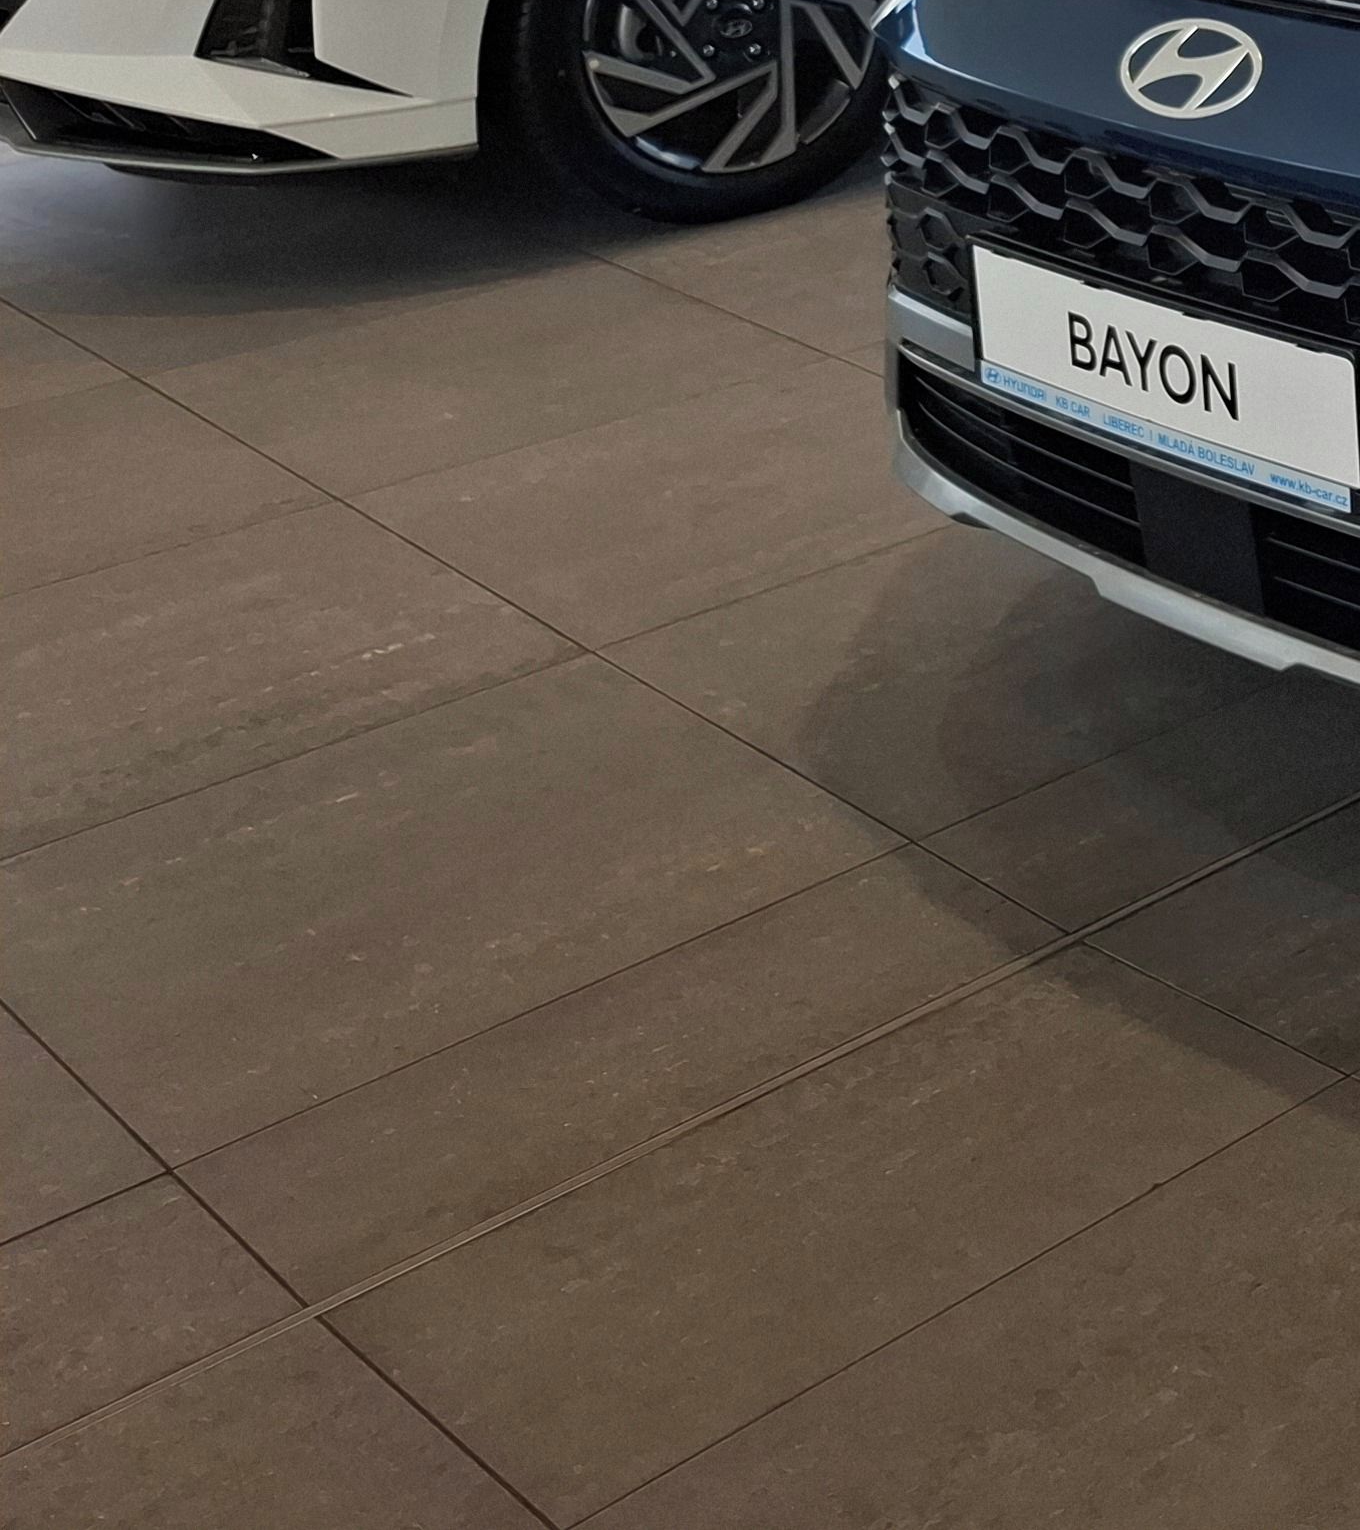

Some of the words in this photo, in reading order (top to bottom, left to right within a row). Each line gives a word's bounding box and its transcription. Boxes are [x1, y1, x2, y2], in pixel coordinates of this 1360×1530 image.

[1066, 310, 1241, 422] BAYON
[1002, 376, 1047, 402] HYUNDAI
[1055, 395, 1069, 410] KB
[1070, 401, 1090, 418] CAR
[1103, 413, 1146, 439] LIBEREC
[1157, 433, 1196, 455] MLADÁ
[1198, 446, 1256, 476] BOLESLAV
[1269, 472, 1349, 507] www.kb-car.cz
